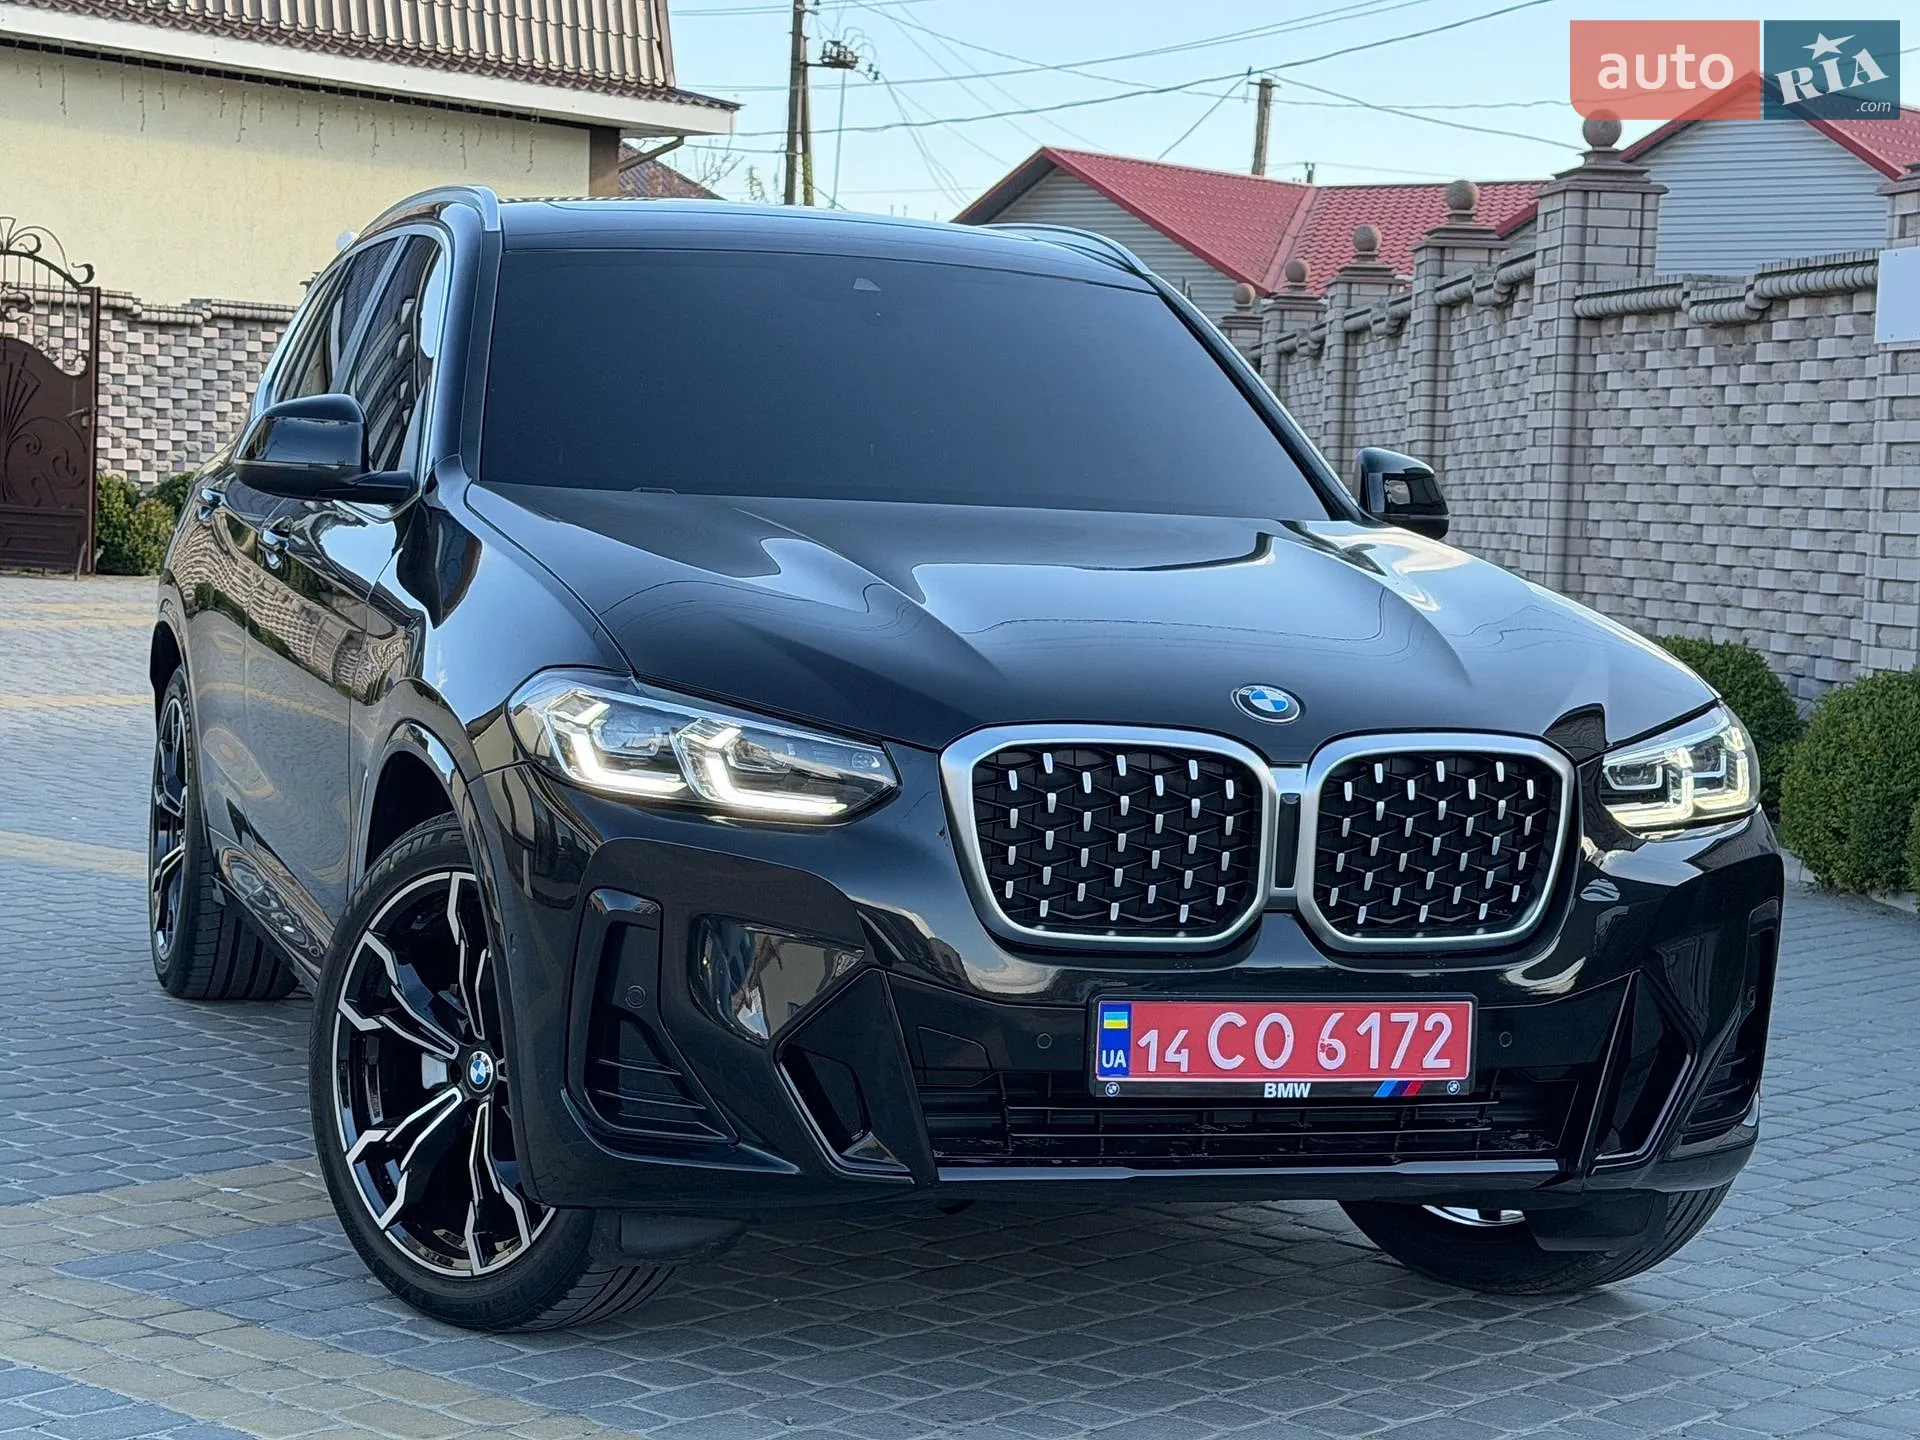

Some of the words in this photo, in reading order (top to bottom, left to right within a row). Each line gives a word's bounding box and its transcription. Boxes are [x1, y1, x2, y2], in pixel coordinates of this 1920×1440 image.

[1137, 1029, 1190, 1073] 14
[1207, 1012, 1294, 1071] CO
[1317, 1011, 1453, 1071] 6172
[1101, 1049, 1127, 1069] UA
[1263, 1081, 1312, 1099] BMW
